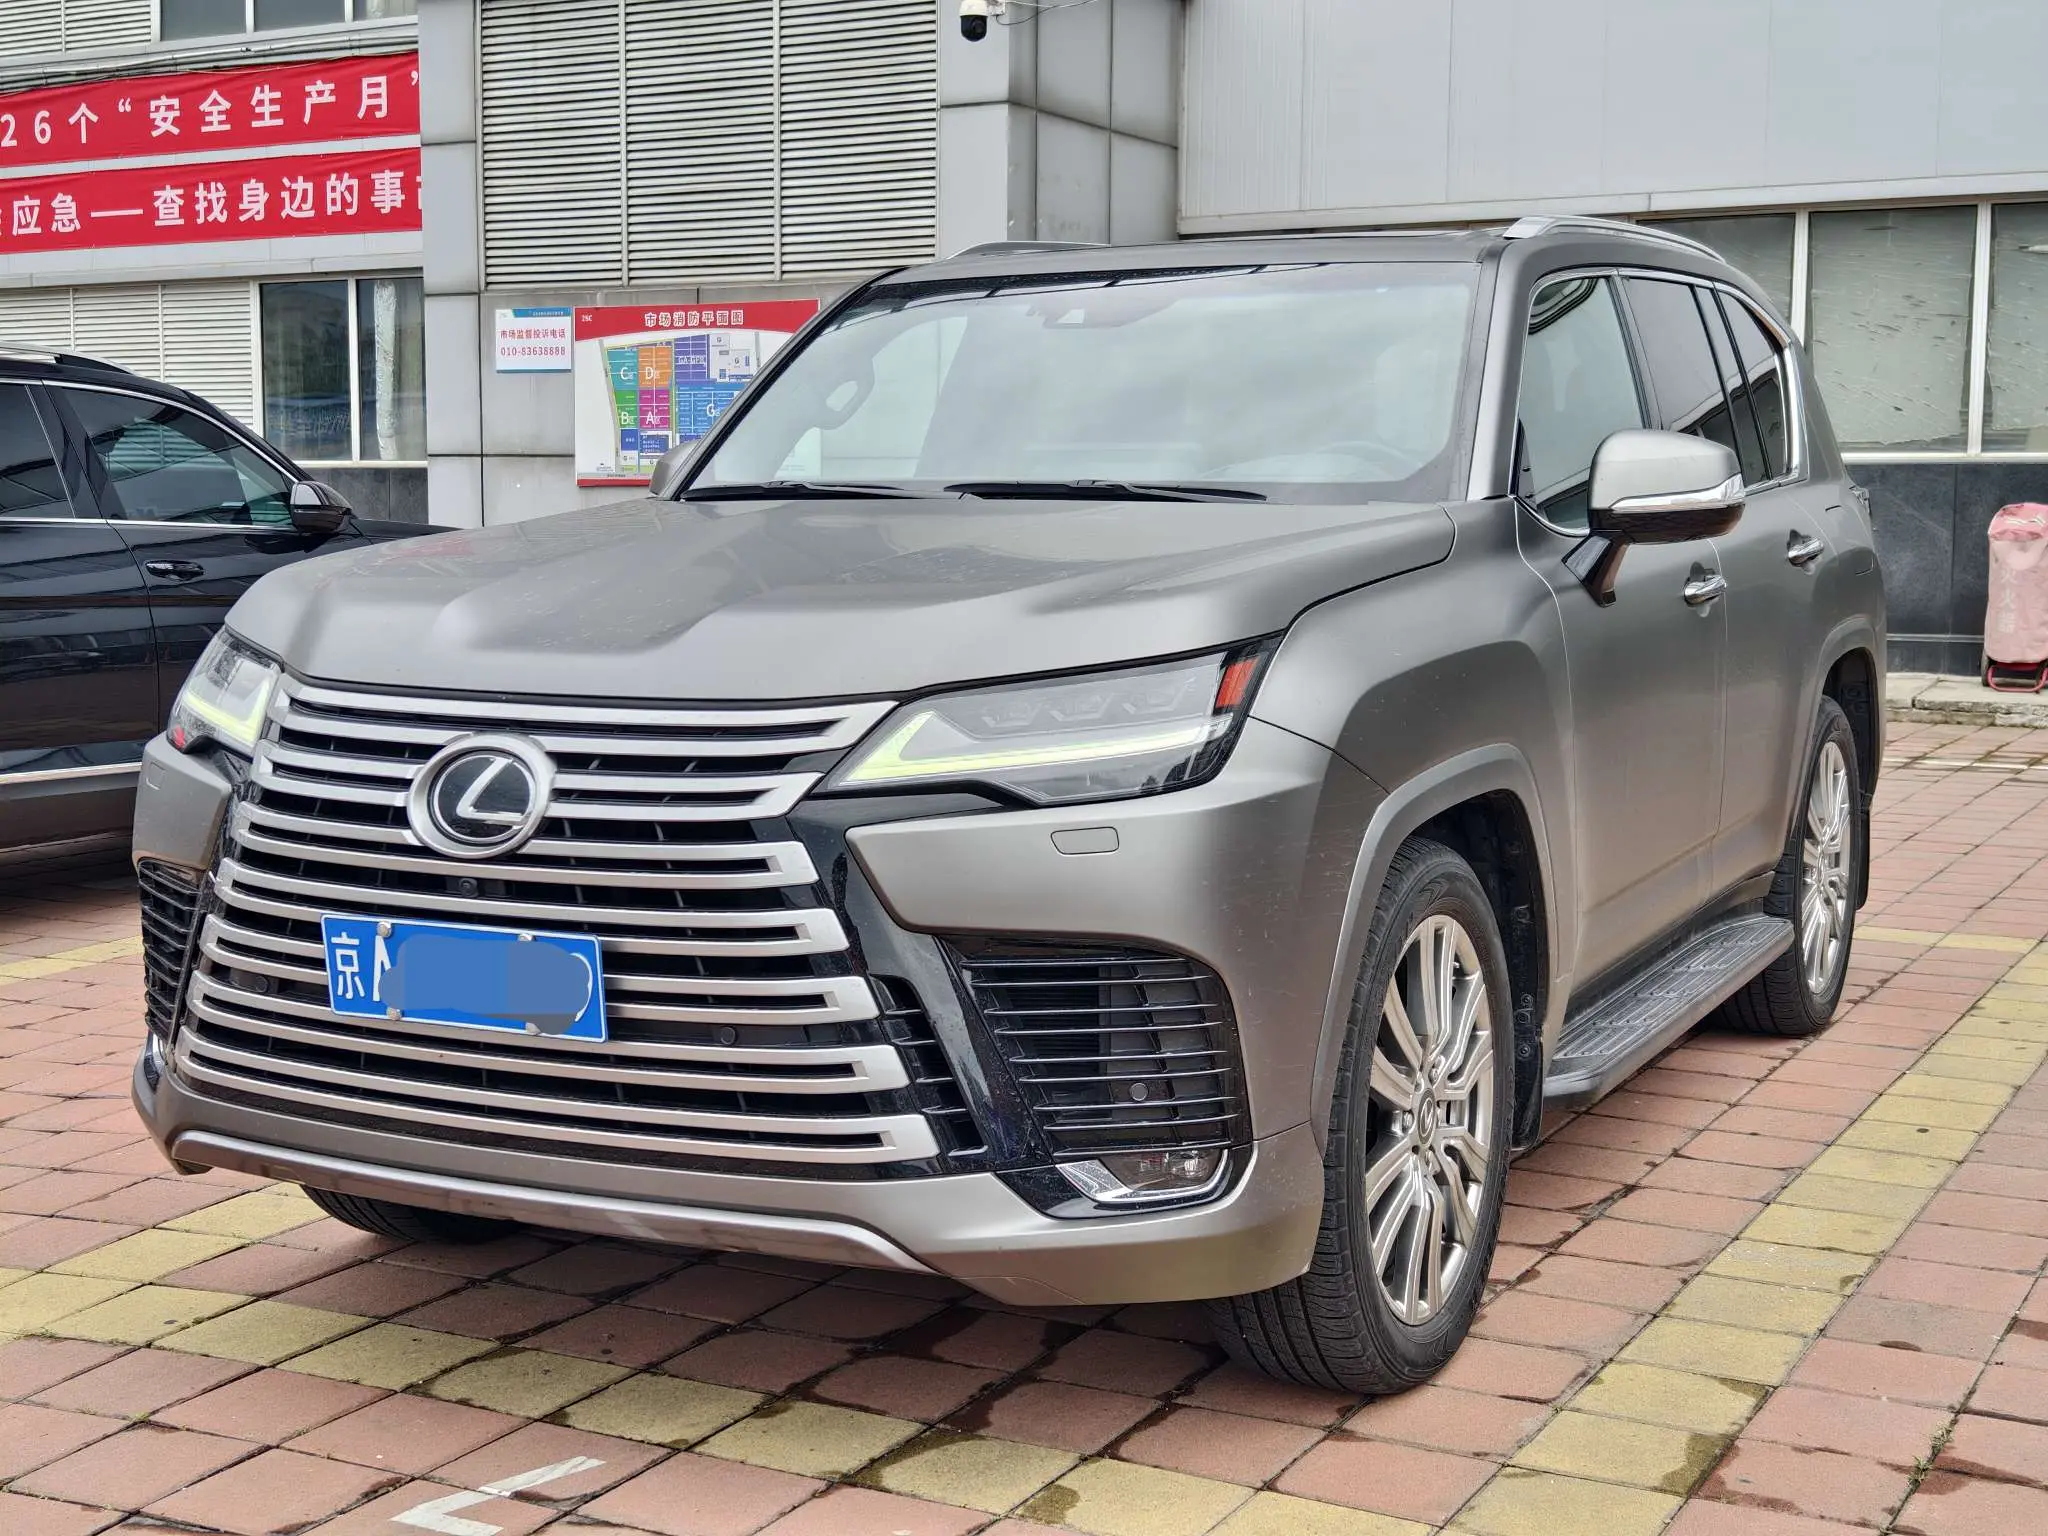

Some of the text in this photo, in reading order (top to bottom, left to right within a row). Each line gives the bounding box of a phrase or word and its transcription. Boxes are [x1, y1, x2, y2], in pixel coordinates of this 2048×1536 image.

[644, 309, 744, 327] 市场消防平面图
[500, 327, 566, 339] 市场监督投诉电话
[500, 346, 566, 356] 010-83638888
